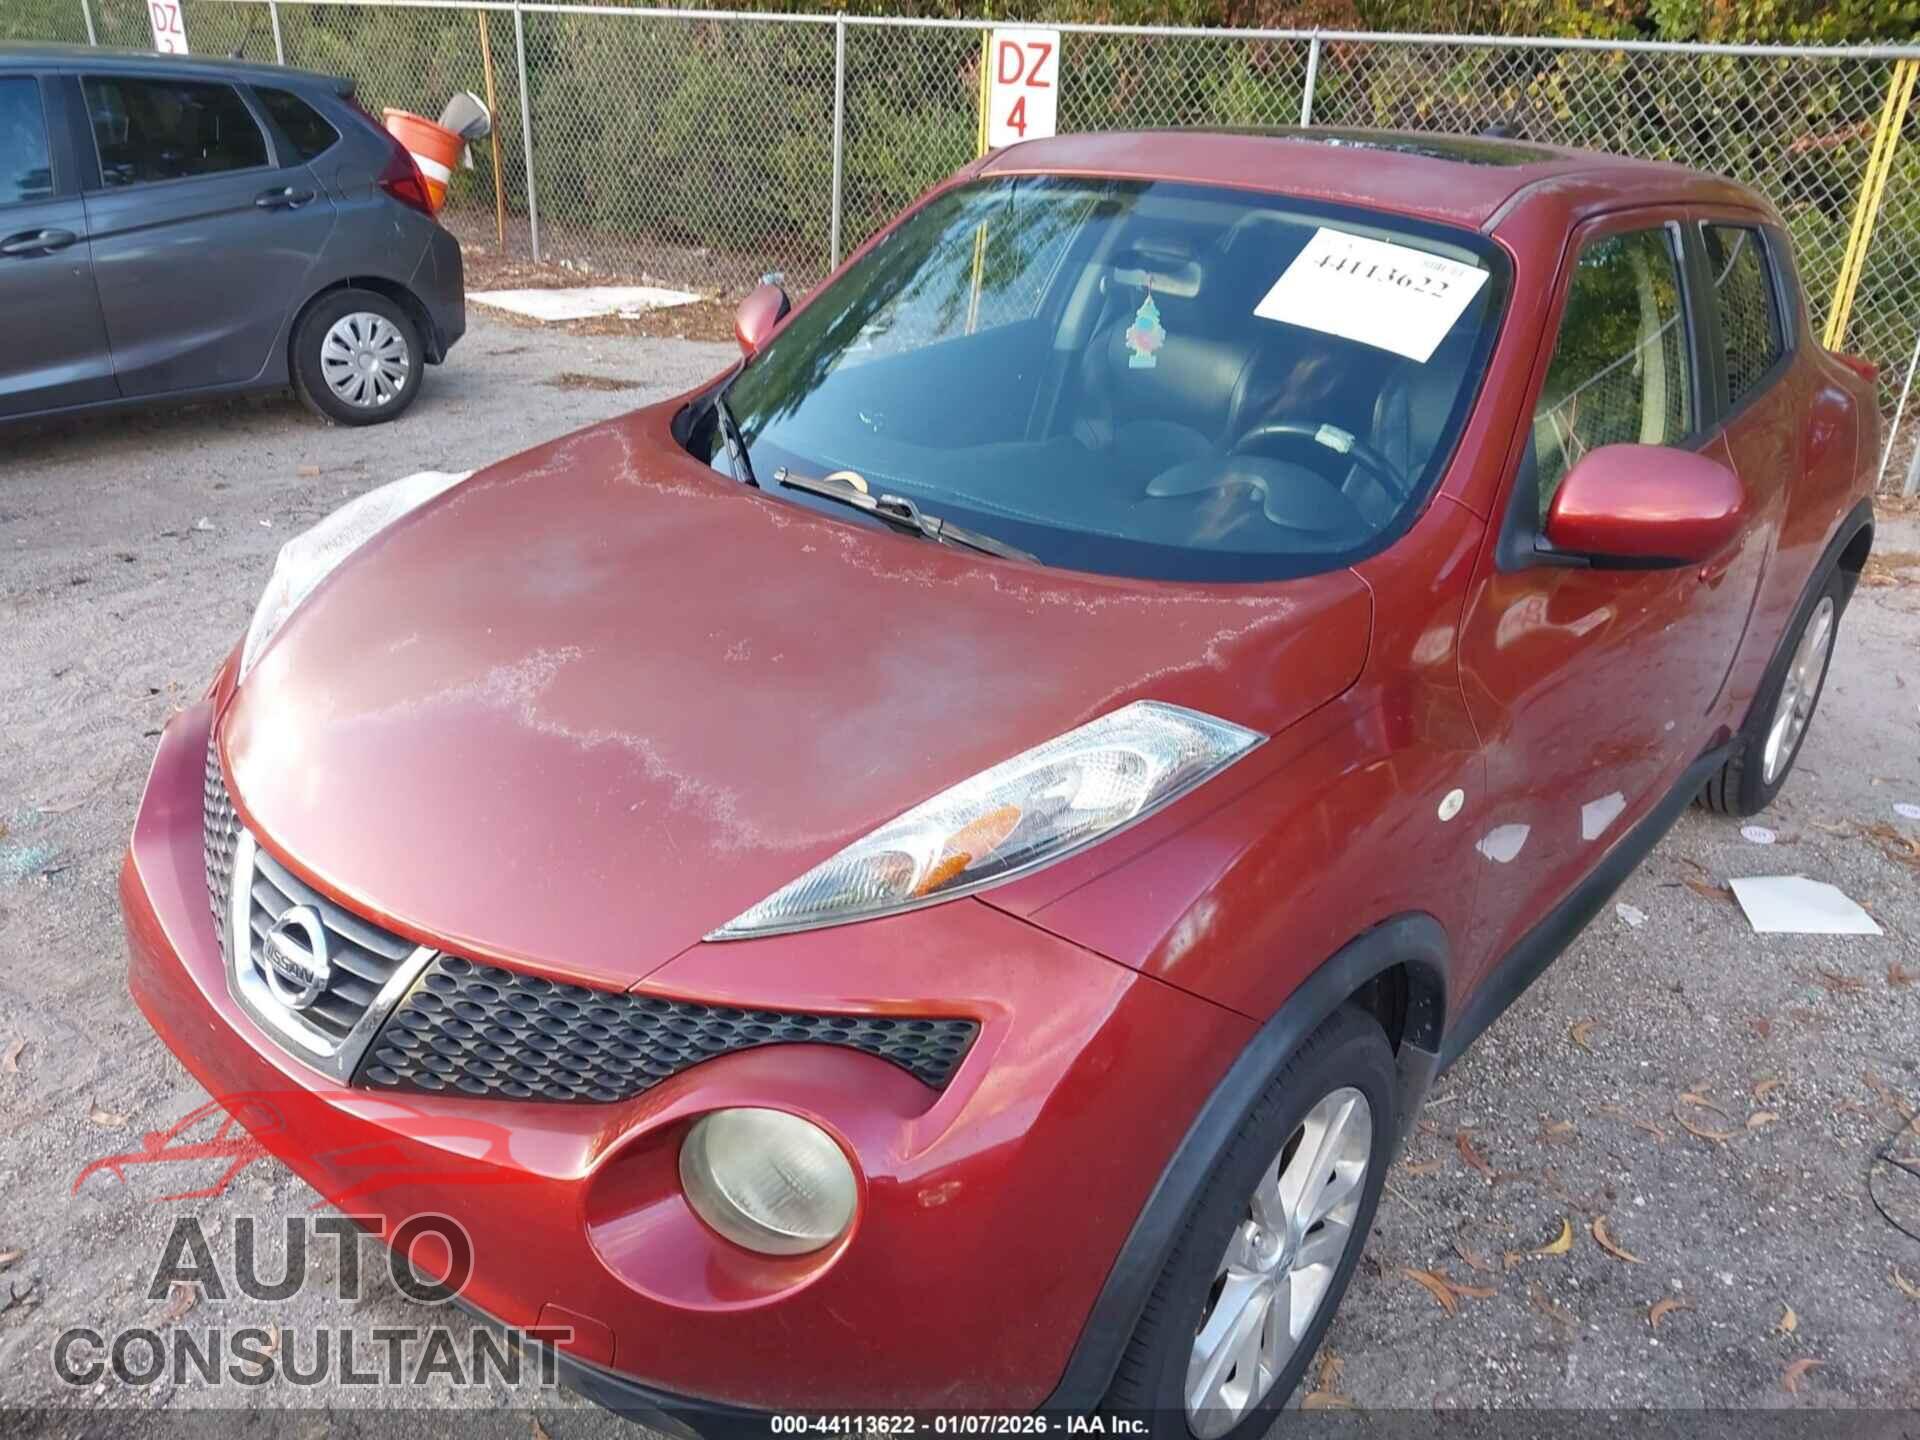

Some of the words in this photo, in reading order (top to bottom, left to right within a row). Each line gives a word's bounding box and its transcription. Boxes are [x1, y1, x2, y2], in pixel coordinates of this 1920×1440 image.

[152, 3, 181, 34] DZ
[998, 40, 1052, 88] DZ
[1006, 95, 1027, 137] 4
